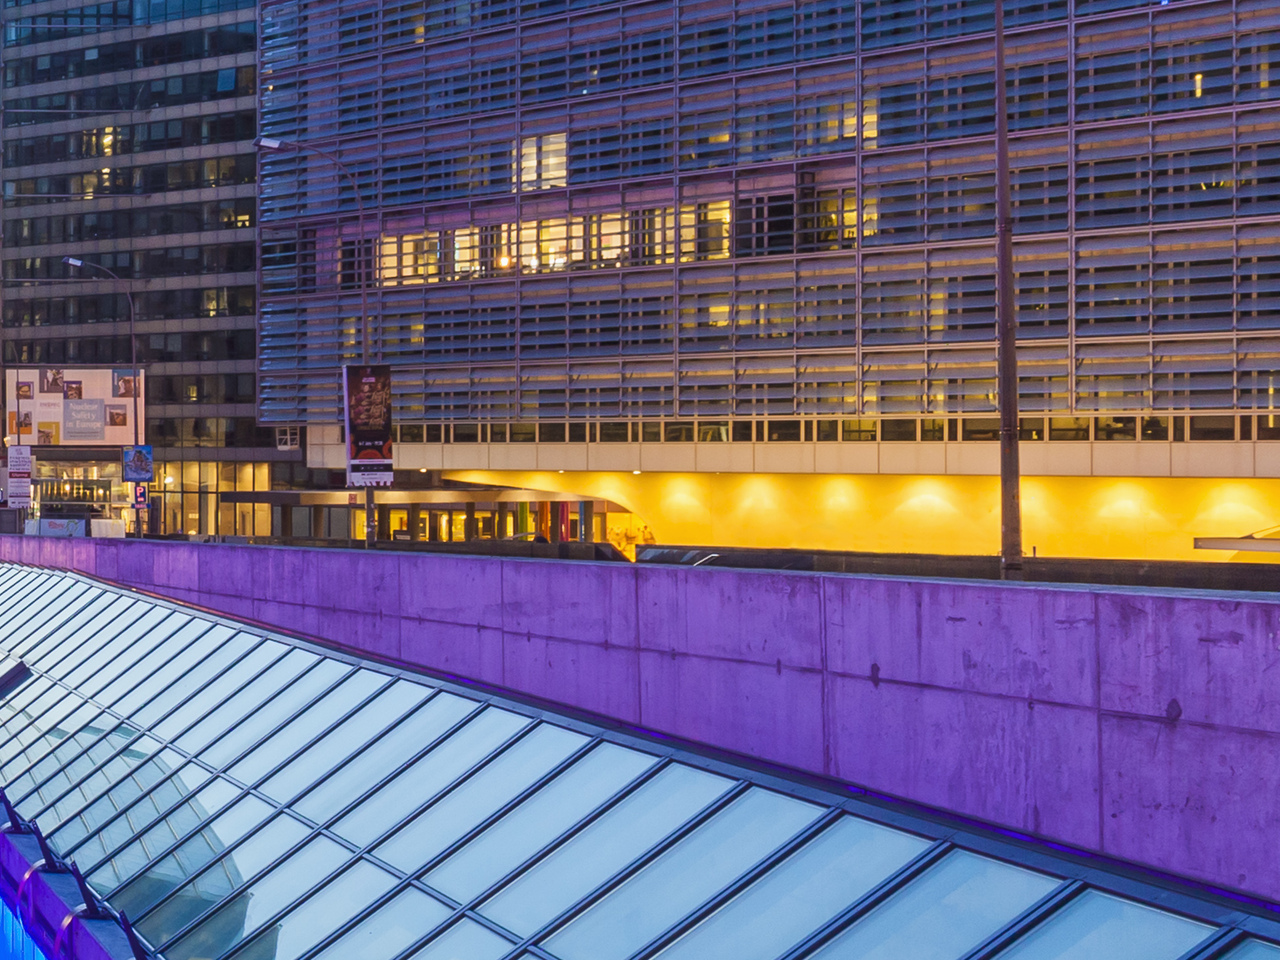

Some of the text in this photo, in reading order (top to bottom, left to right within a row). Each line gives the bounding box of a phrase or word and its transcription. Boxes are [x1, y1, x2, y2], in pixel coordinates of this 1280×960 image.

[69, 402, 98, 410] Nuclear
[71, 411, 96, 420] Safety
[75, 420, 102, 429] Europe
[136, 486, 144, 497] P
